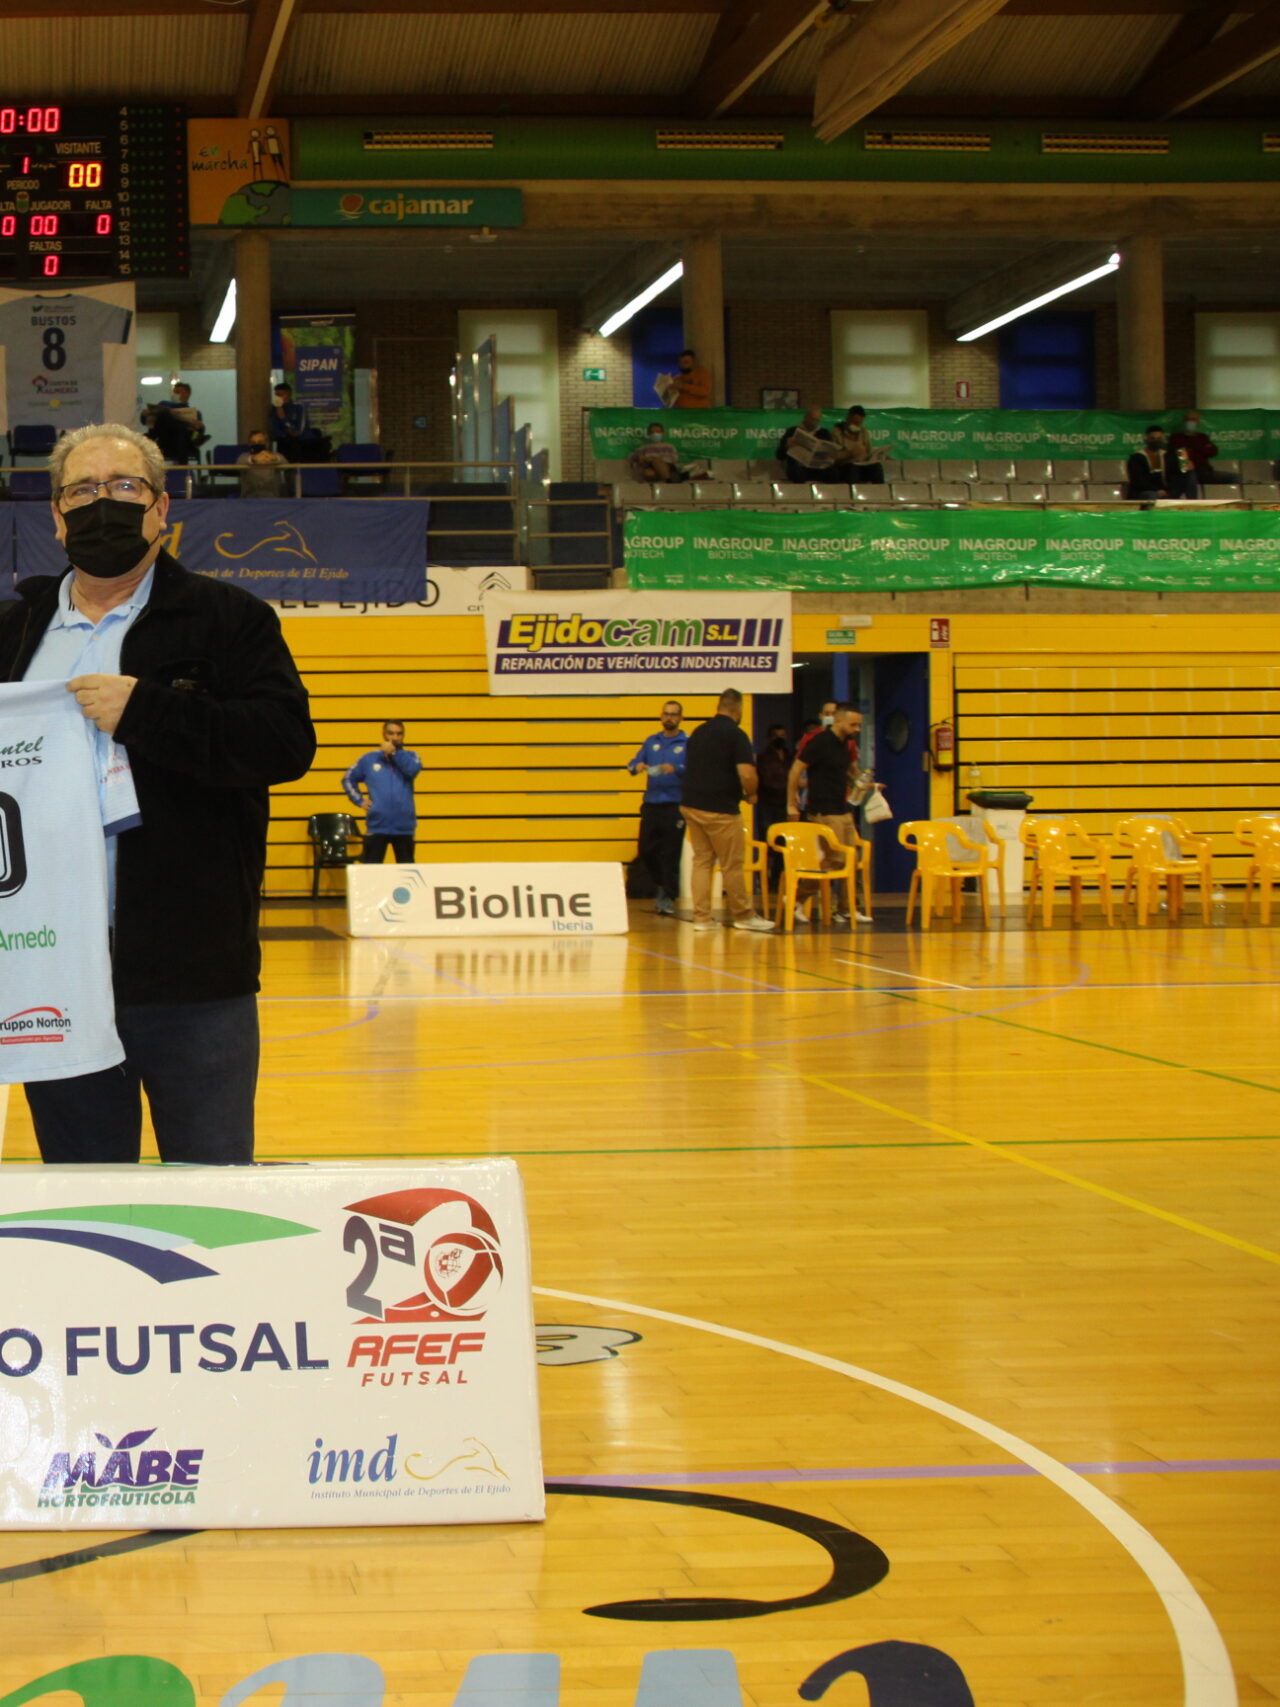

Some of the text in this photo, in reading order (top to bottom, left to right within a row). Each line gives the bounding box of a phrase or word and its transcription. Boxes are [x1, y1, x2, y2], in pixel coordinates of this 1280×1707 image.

[54, 142, 102, 155] VISITANTE
[191, 152, 250, 171] marcha
[68, 162, 102, 188] 00
[6, 179, 40, 190] PERIODO
[30, 199, 112, 211] JUGADOR FALTA
[368, 193, 474, 221] cajamar
[1, 215, 16, 236] 0
[29, 213, 111, 236] 00 0
[28, 240, 62, 251] FALTAS
[44, 255, 58, 276] 0
[31, 315, 77, 327] BUSTOS
[41, 326, 67, 372] 8
[298, 358, 338, 372] SIPAN
[669, 428, 738, 439] INAGROUP
[897, 430, 965, 442] INAGROUP
[972, 431, 1040, 442] INAGROUP
[1048, 433, 1115, 445] INAGROUP
[693, 537, 773, 550] INAGROUP
[782, 538, 862, 551] INAGROUP
[871, 538, 949, 550] INAGROUP
[959, 538, 1037, 551] INAGROUP
[1046, 538, 1124, 551] INAGROUP
[1132, 539, 1211, 551] INAGROUP
[708, 551, 753, 560] BIOTECH
[973, 552, 1017, 561] BIOTECH
[1060, 552, 1105, 561] BIOTECH
[239, 567, 285, 580] Deportes
[287, 568, 301, 579] de
[303, 568, 316, 579] El
[319, 567, 349, 580] Ejido
[501, 654, 773, 671] REPARACIÓN DE VEHÍCULOS INDUSTRIALES
[433, 884, 592, 920] Bioline
[552, 920, 593, 931] Iberia
[36, 1017, 71, 1028] Norton
[65, 1321, 329, 1374] FUTSAL
[346, 1331, 486, 1368] RFEF
[361, 1370, 468, 1387] FUTSAL
[307, 1433, 398, 1484] imd
[310, 1484, 511, 1500] Instituto Municipal de Deportes de El Ejido
[37, 1491, 196, 1508] HORTOFRUTICOLA
